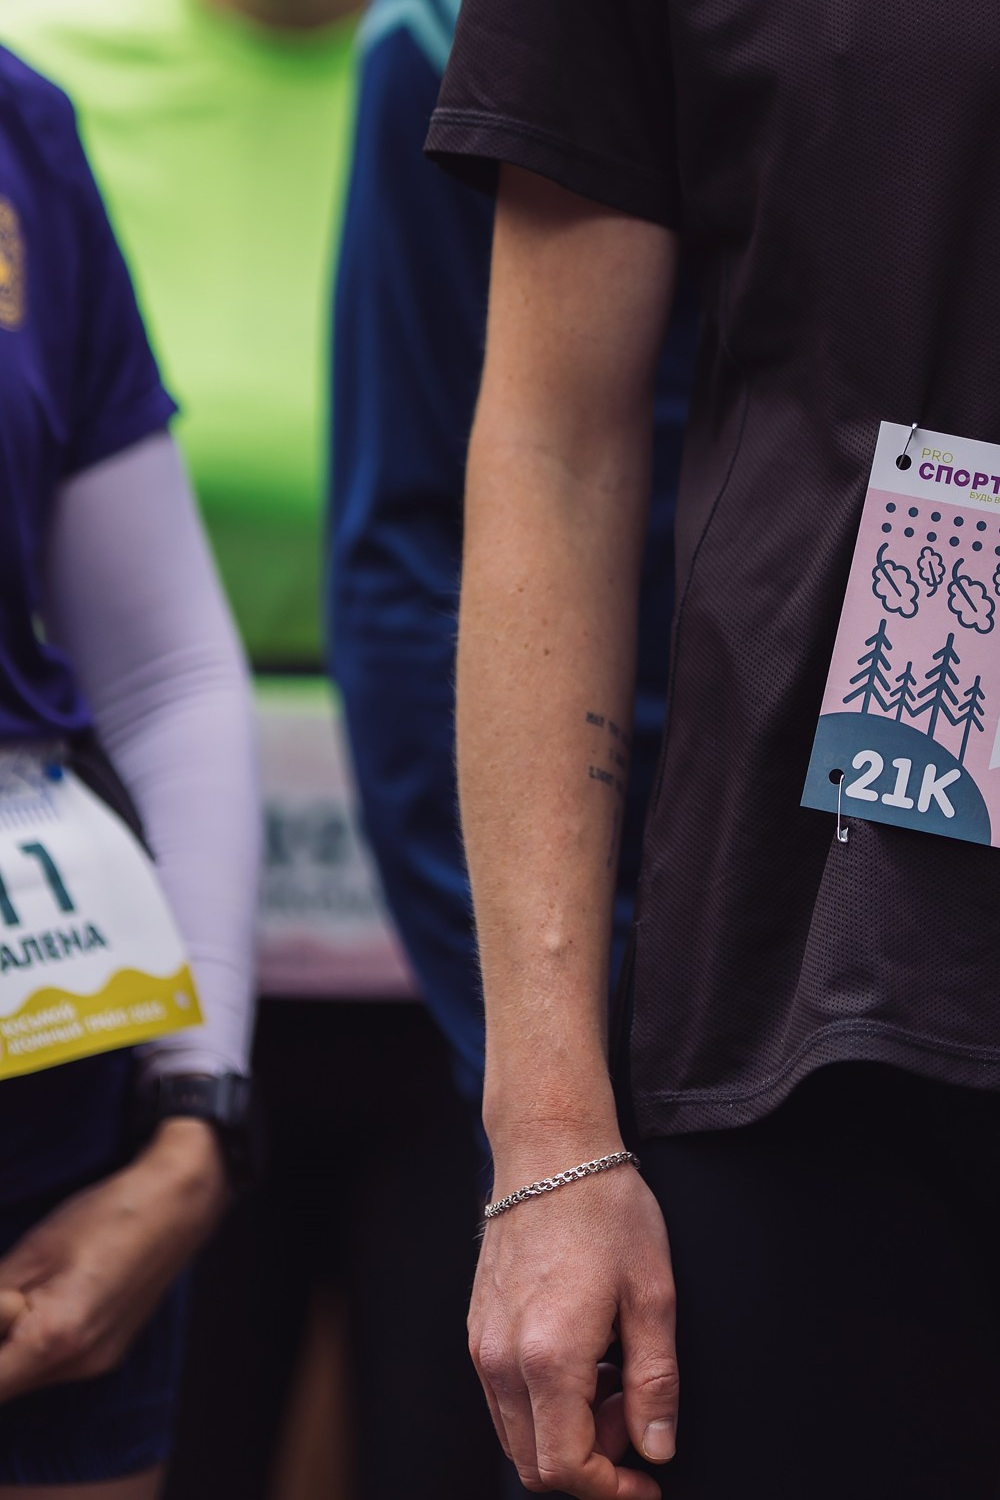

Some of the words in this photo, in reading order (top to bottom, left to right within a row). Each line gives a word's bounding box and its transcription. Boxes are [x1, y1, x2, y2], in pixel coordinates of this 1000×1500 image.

[921, 447, 953, 464] PRO
[969, 491, 993, 503] БУДЬ
[994, 496, 1000, 504] В
